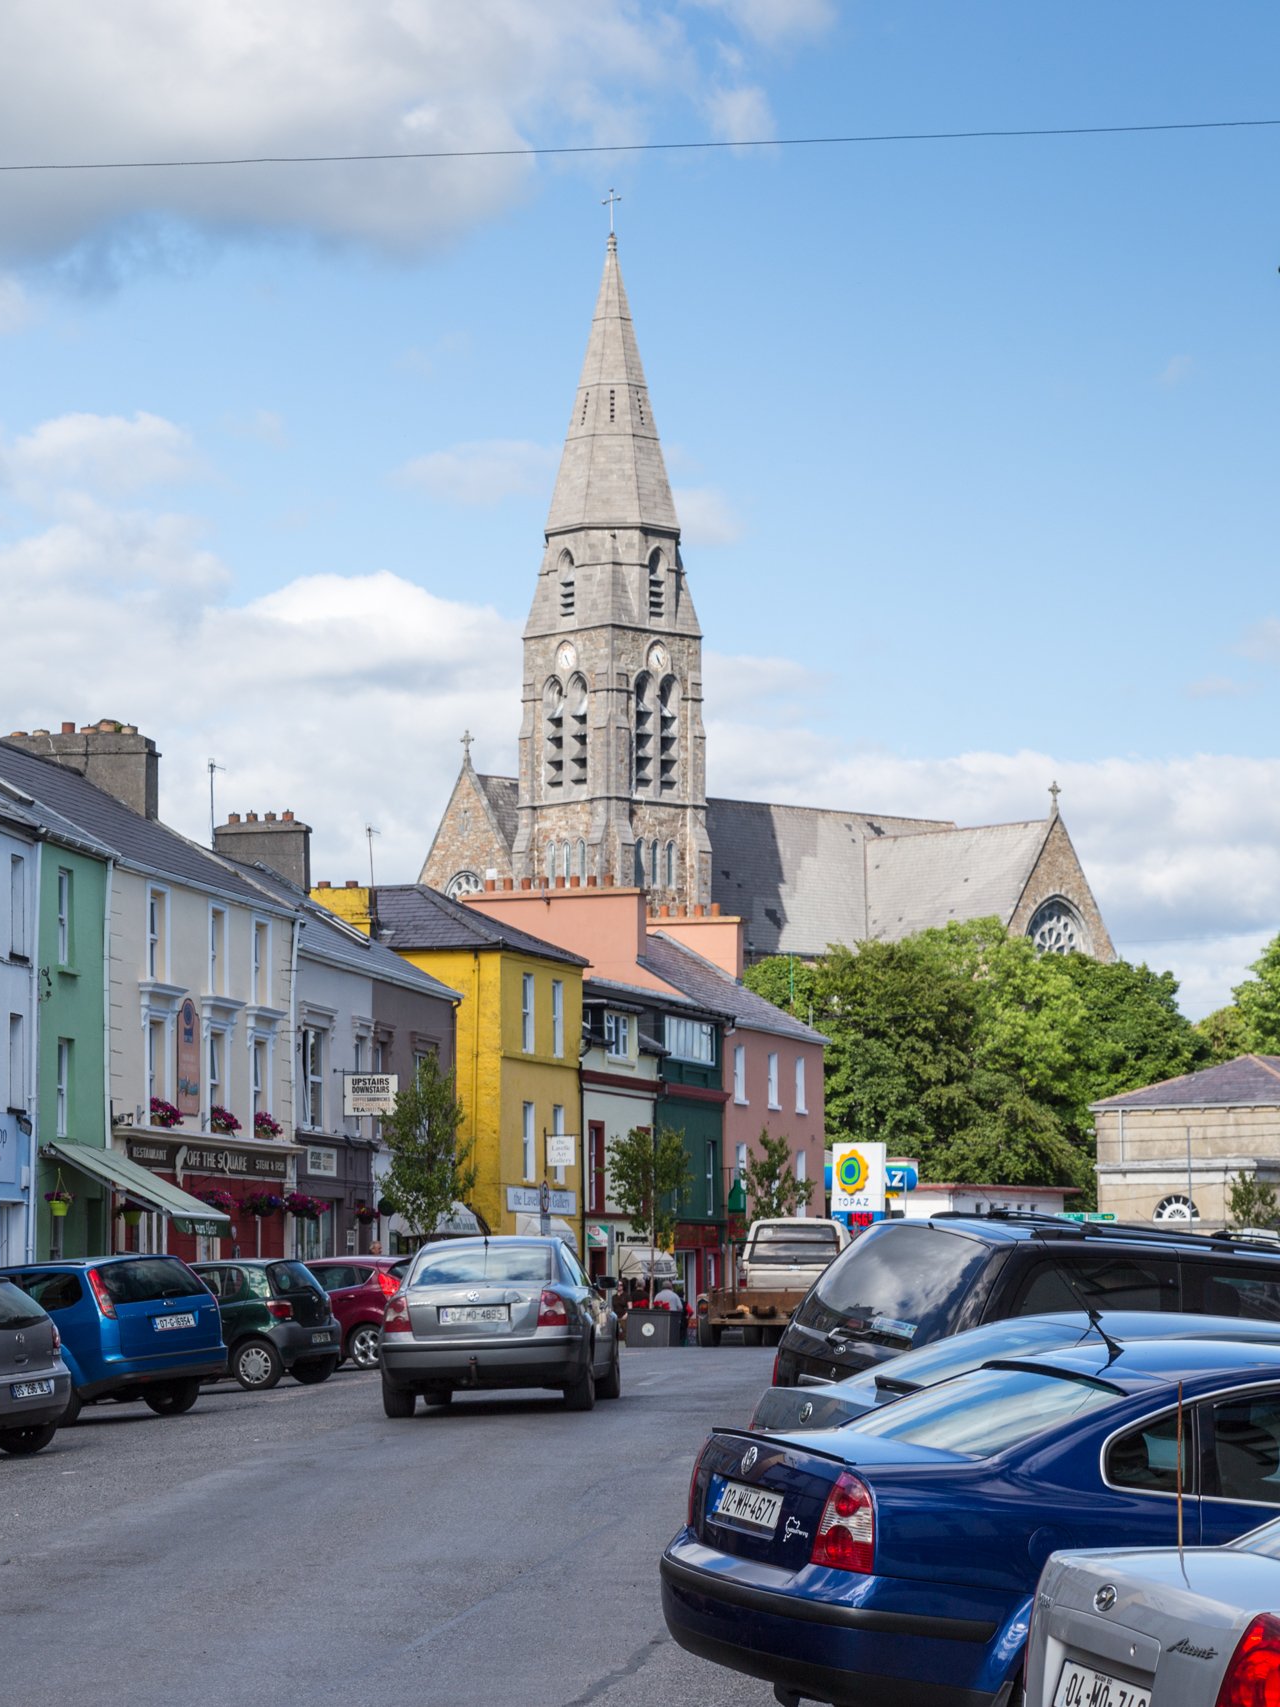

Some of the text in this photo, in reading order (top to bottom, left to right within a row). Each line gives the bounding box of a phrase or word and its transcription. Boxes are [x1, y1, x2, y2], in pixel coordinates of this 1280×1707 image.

[352, 1077, 390, 1086] UPSTAIRS
[352, 1086, 390, 1094] DOWNSTAIRS
[132, 1146, 167, 1160] RESTAURANT
[186, 1151, 248, 1175] OFF THE SQUARE
[838, 1198, 869, 1206] TOPAZ
[722, 1489, 777, 1524] 02-WH-4671
[1167, 1638, 1218, 1660] Accent
